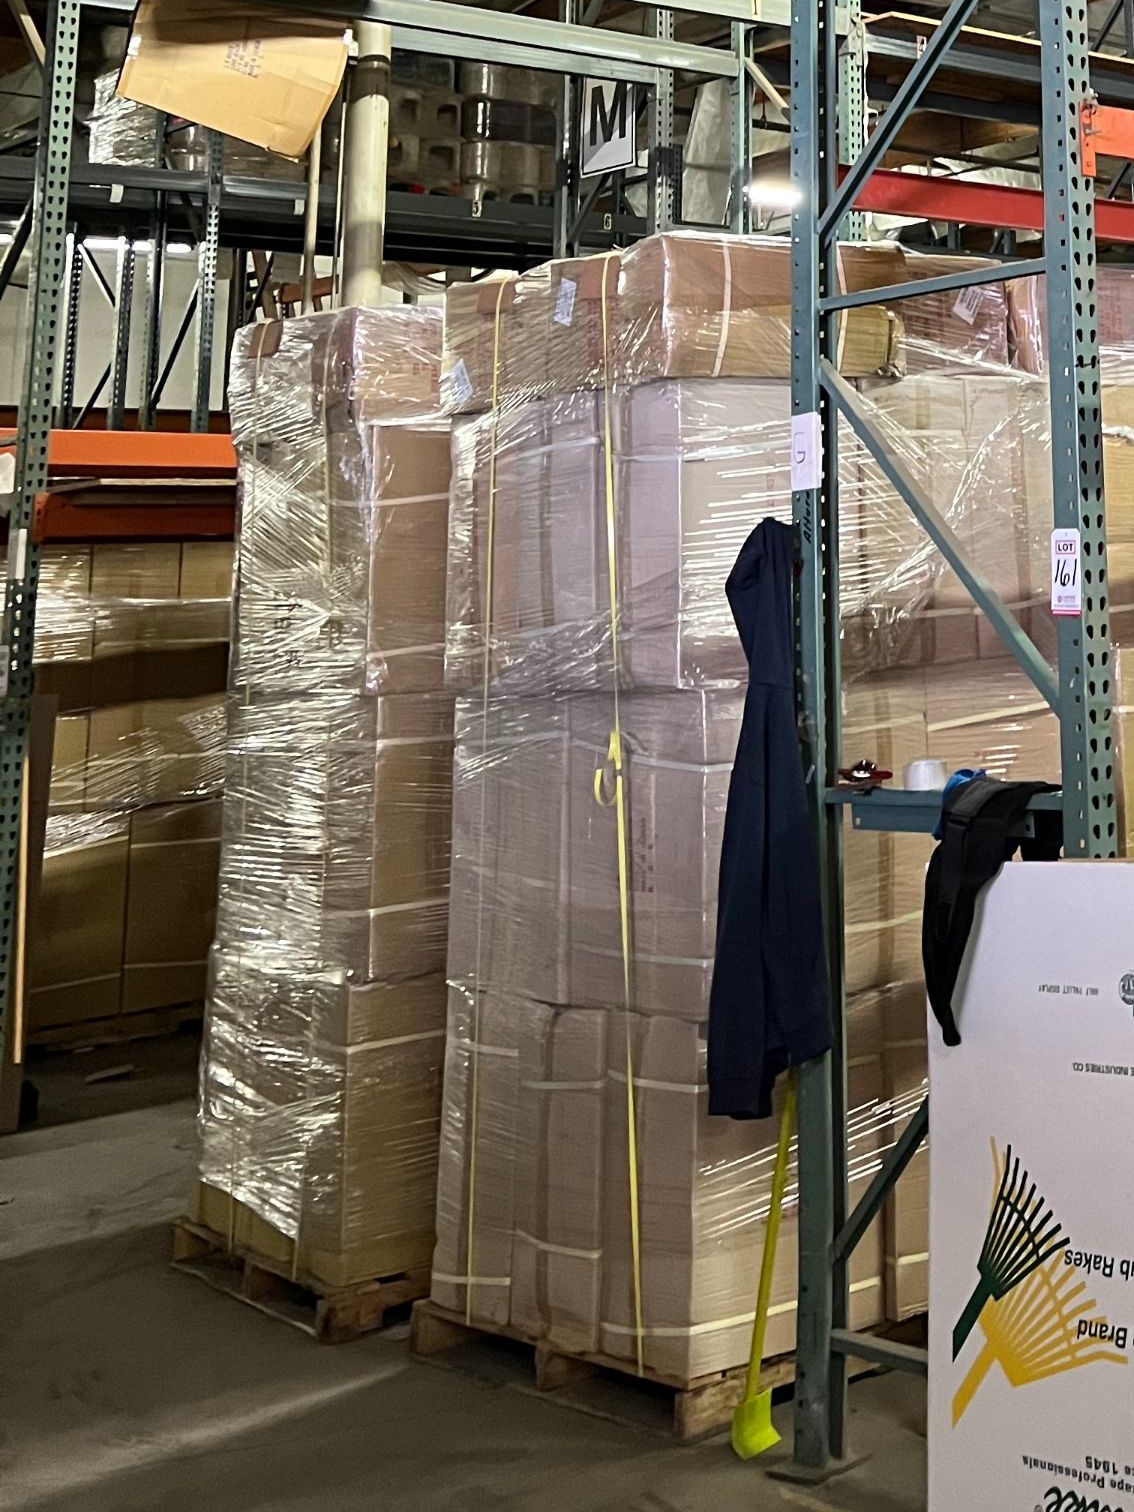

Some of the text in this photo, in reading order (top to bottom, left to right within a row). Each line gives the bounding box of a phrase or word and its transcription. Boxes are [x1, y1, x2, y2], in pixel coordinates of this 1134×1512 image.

[589, 80, 628, 147] M
[1057, 543, 1073, 552] LOT
[1054, 558, 1077, 586] 161
[1085, 1063, 1129, 1076] INDUSTRIES
[1064, 1249, 1115, 1278] Rakes
[1077, 1319, 1127, 1349] Brand
[1022, 1455, 1105, 1490] Professionals
[1085, 1456, 1118, 1475] 1945
